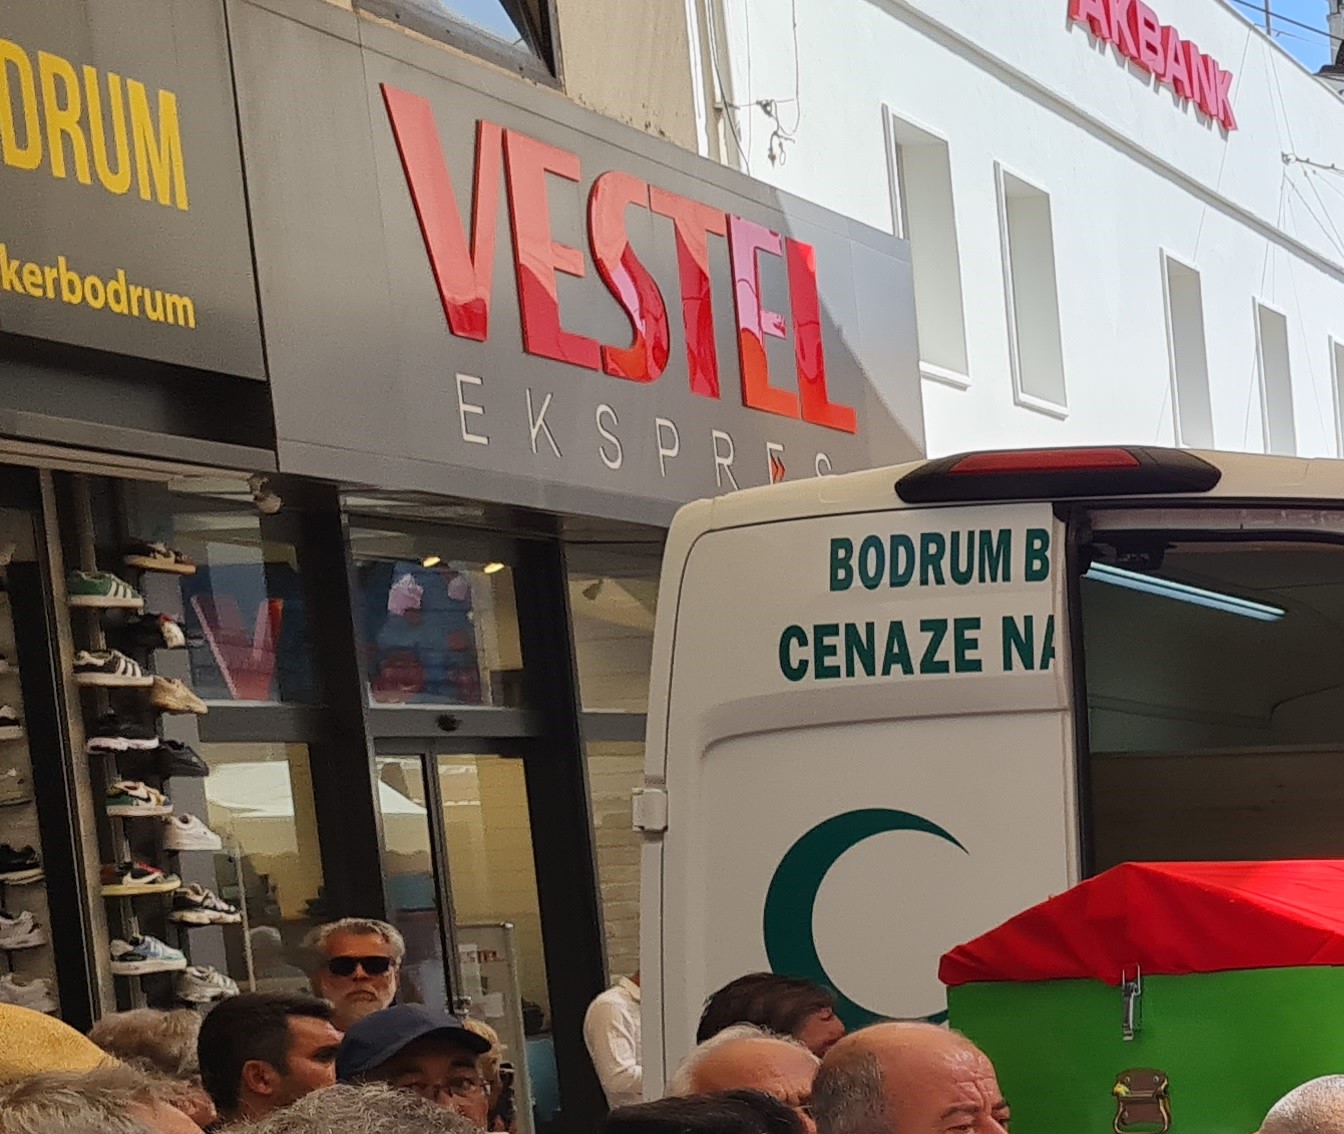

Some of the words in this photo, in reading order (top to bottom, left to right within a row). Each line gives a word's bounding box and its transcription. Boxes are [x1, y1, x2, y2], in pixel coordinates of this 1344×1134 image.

[0, 38, 189, 212] DRUM
[0, 242, 197, 329] kerbodrum
[380, 82, 858, 434] VESTEL
[829, 528, 1012, 592] BODRUM
[1025, 528, 1050, 582] B
[779, 616, 981, 682] CENAZE
